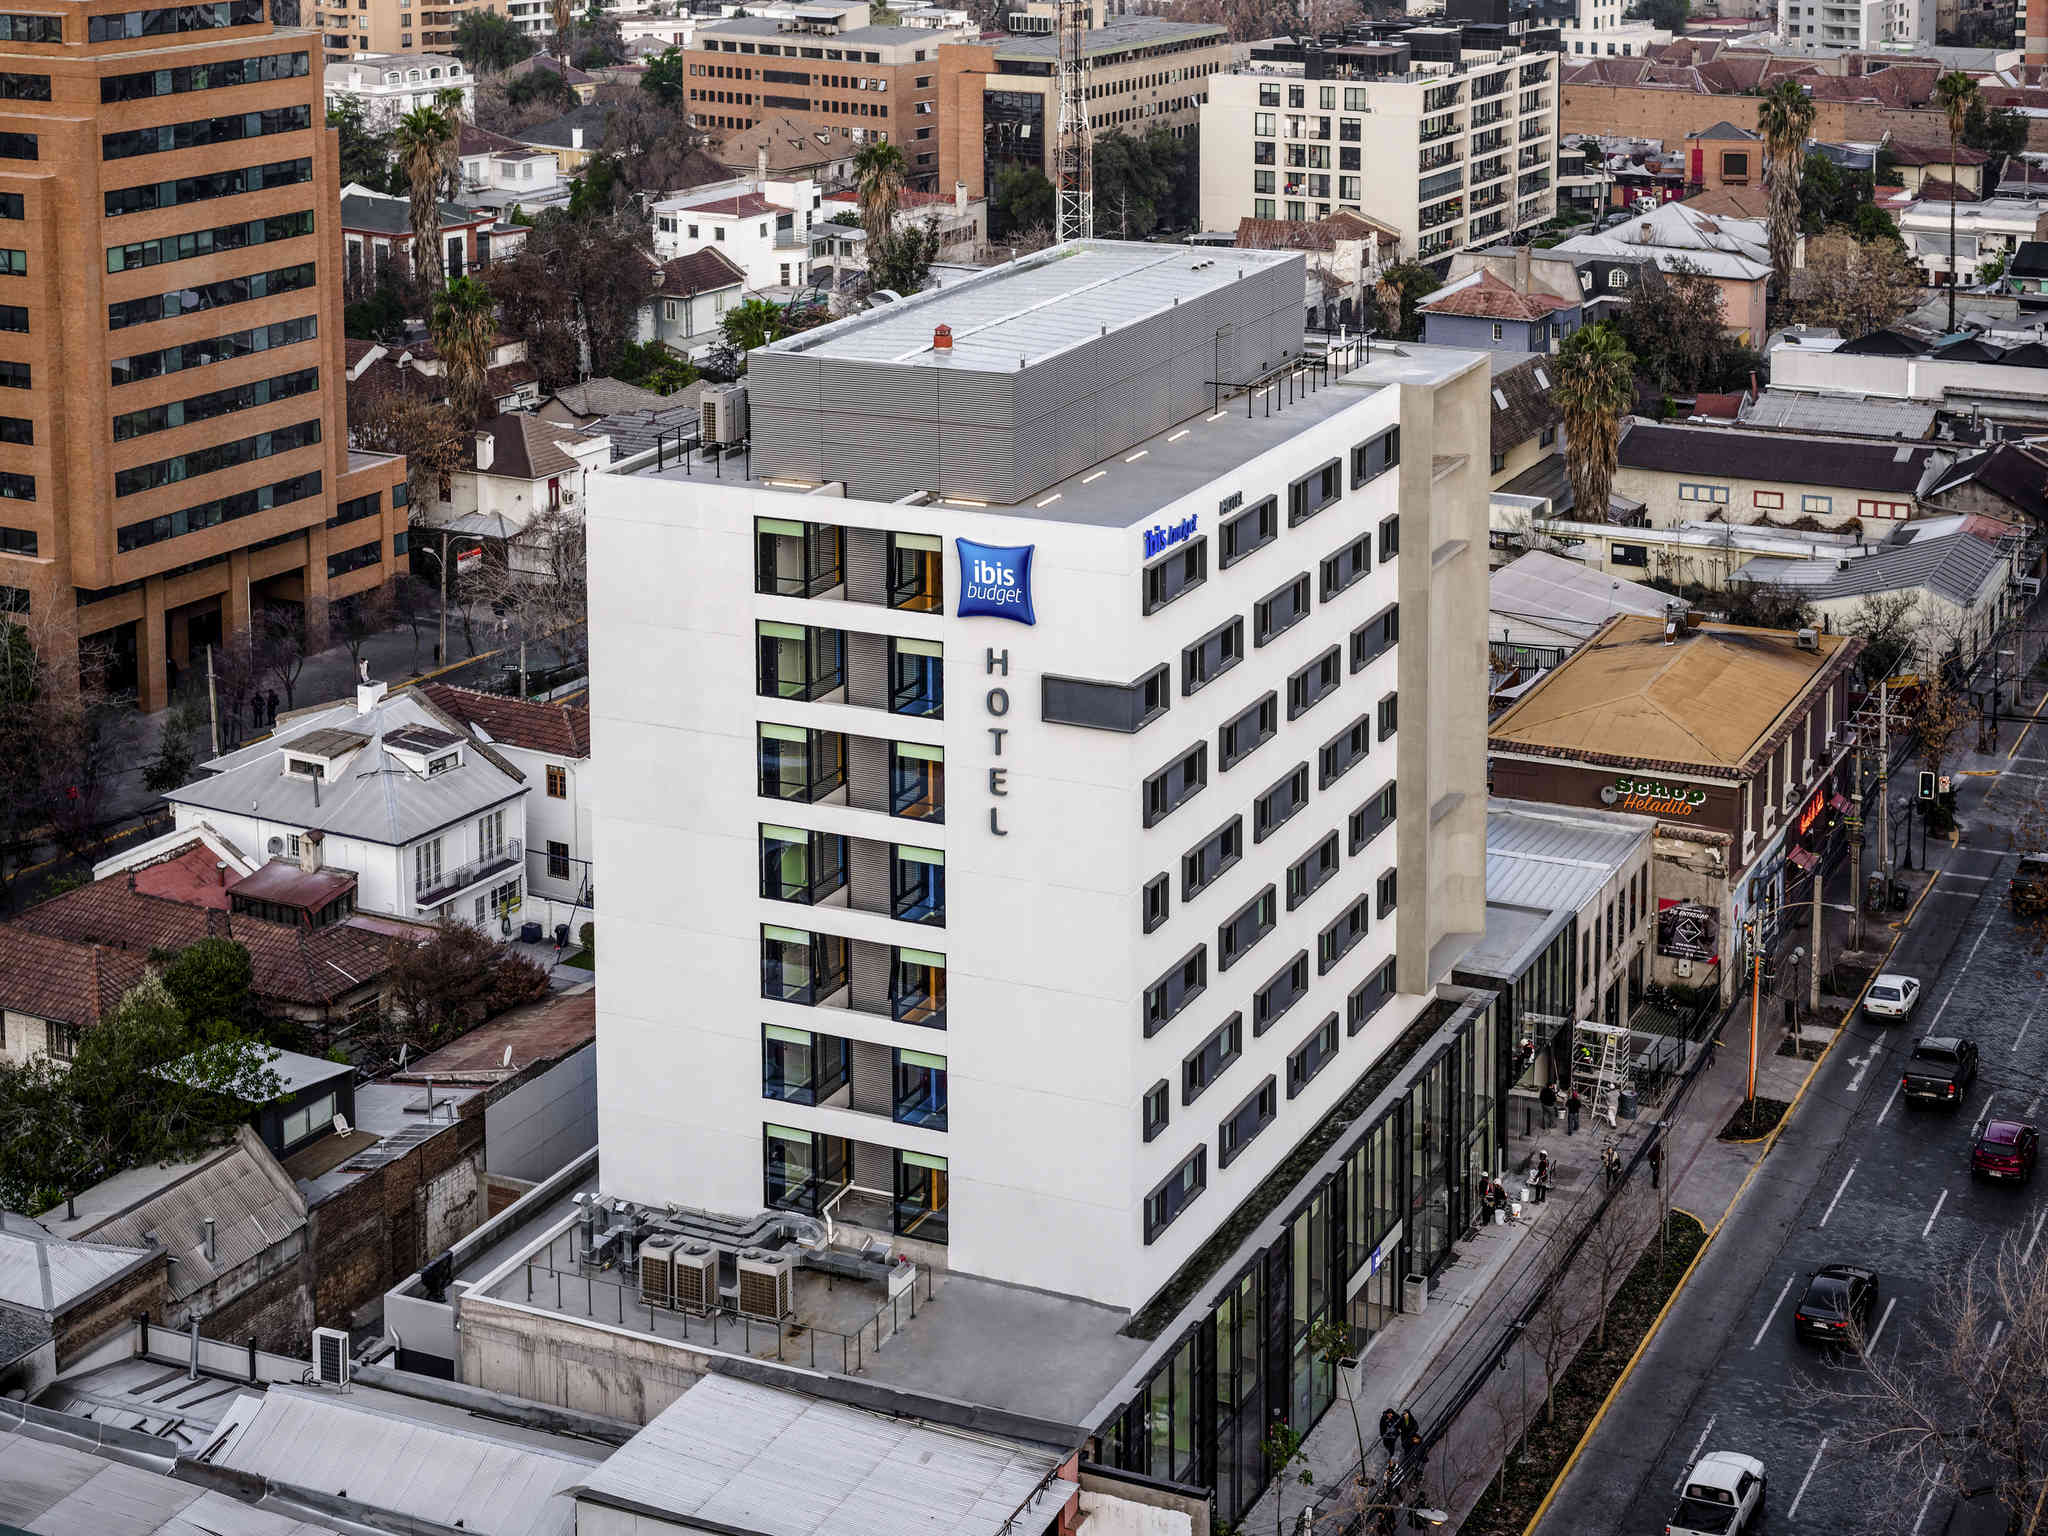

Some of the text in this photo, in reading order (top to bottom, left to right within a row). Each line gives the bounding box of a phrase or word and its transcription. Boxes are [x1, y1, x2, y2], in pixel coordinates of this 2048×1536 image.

[1144, 514, 1198, 559] ibis budget
[974, 560, 1015, 586] ibis
[967, 582, 1022, 605] budget
[986, 647, 1009, 836] HOTEL
[1623, 794, 1692, 816] Heladito
